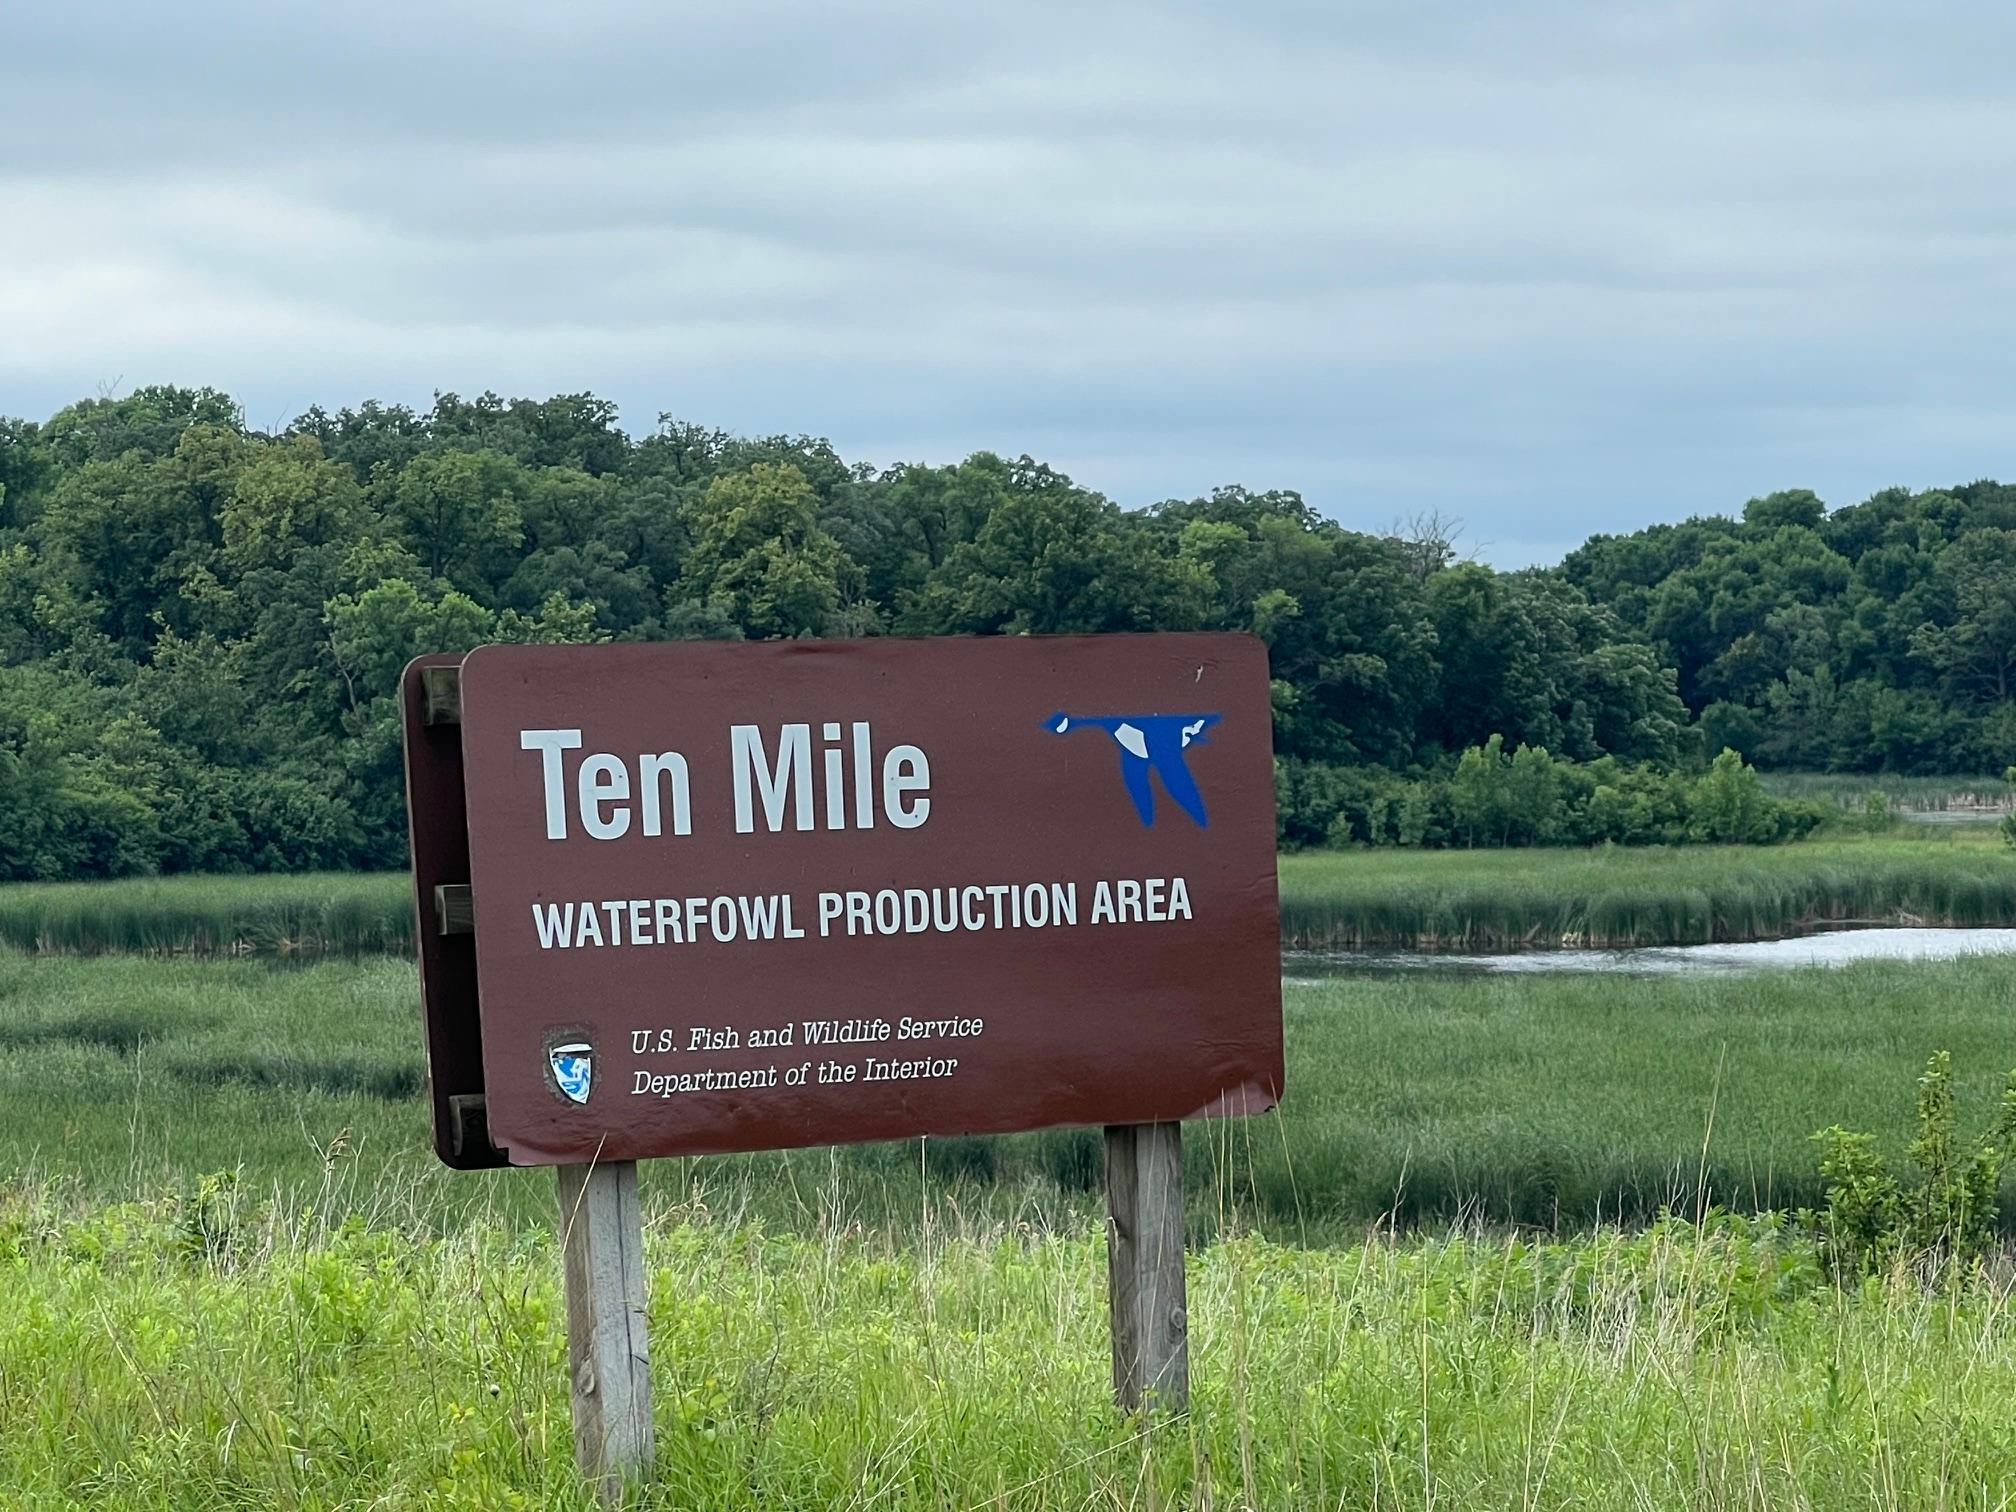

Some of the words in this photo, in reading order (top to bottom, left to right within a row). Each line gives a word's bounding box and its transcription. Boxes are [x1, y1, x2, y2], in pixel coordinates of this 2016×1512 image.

[520, 728, 692, 841] Ten
[730, 721, 932, 834] Mile
[531, 894, 805, 949] WATERFOWL
[818, 882, 1078, 937] PRODUCTION
[1090, 877, 1194, 925] AREA
[631, 1029, 678, 1054] U.S.
[686, 1026, 741, 1052] Fish
[747, 1022, 795, 1049] and
[802, 1018, 891, 1045] Wildlife
[897, 1016, 985, 1040] Service
[630, 1064, 779, 1099] Department
[784, 1061, 812, 1086] of
[817, 1060, 857, 1084] the
[862, 1057, 959, 1082] Interior
